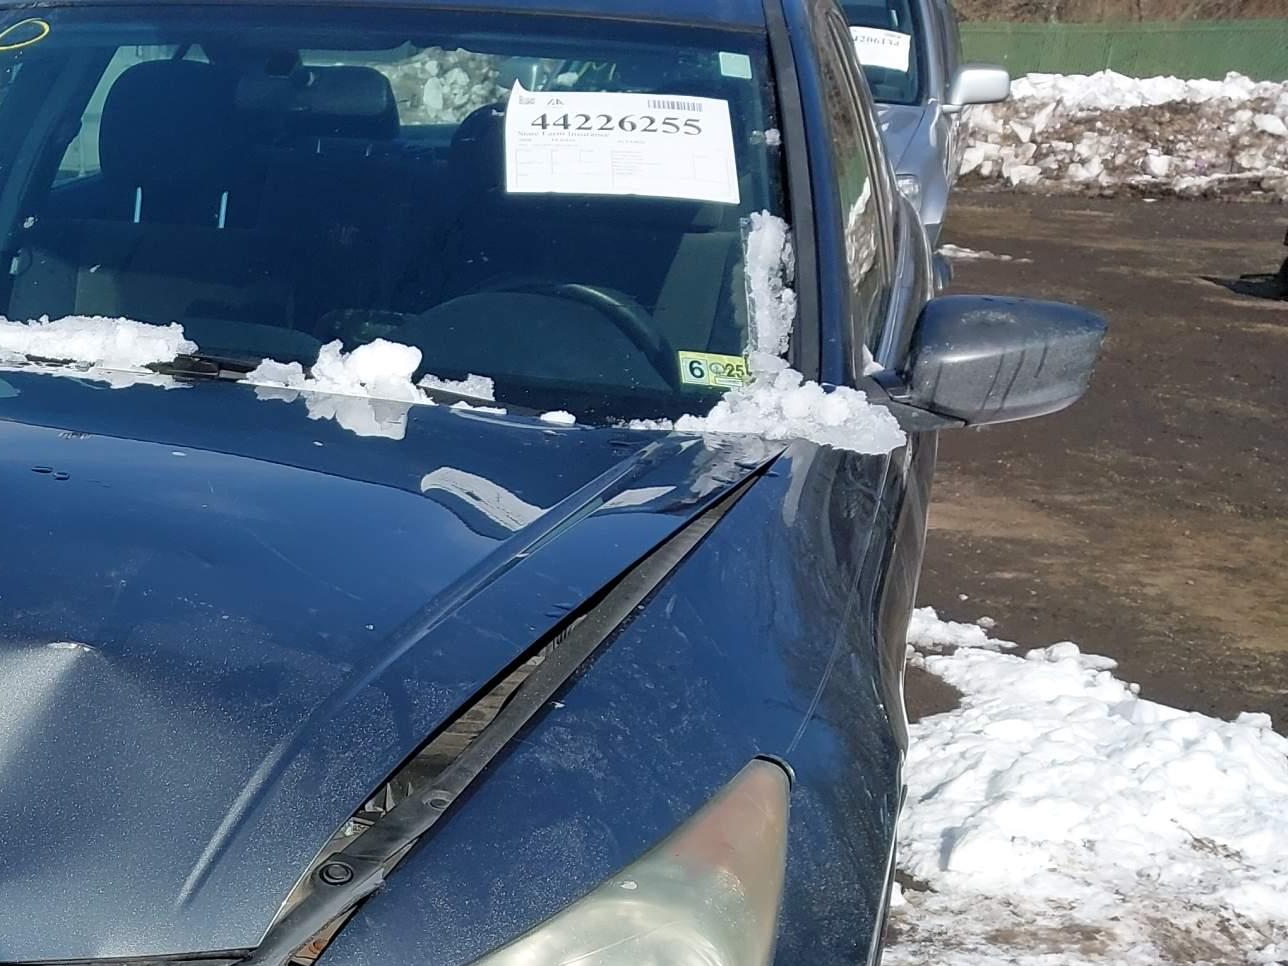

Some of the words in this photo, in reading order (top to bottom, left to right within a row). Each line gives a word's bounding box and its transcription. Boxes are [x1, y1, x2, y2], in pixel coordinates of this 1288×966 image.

[531, 113, 702, 135] 44226255
[689, 360, 705, 378] 6
[725, 363, 744, 378] 25
